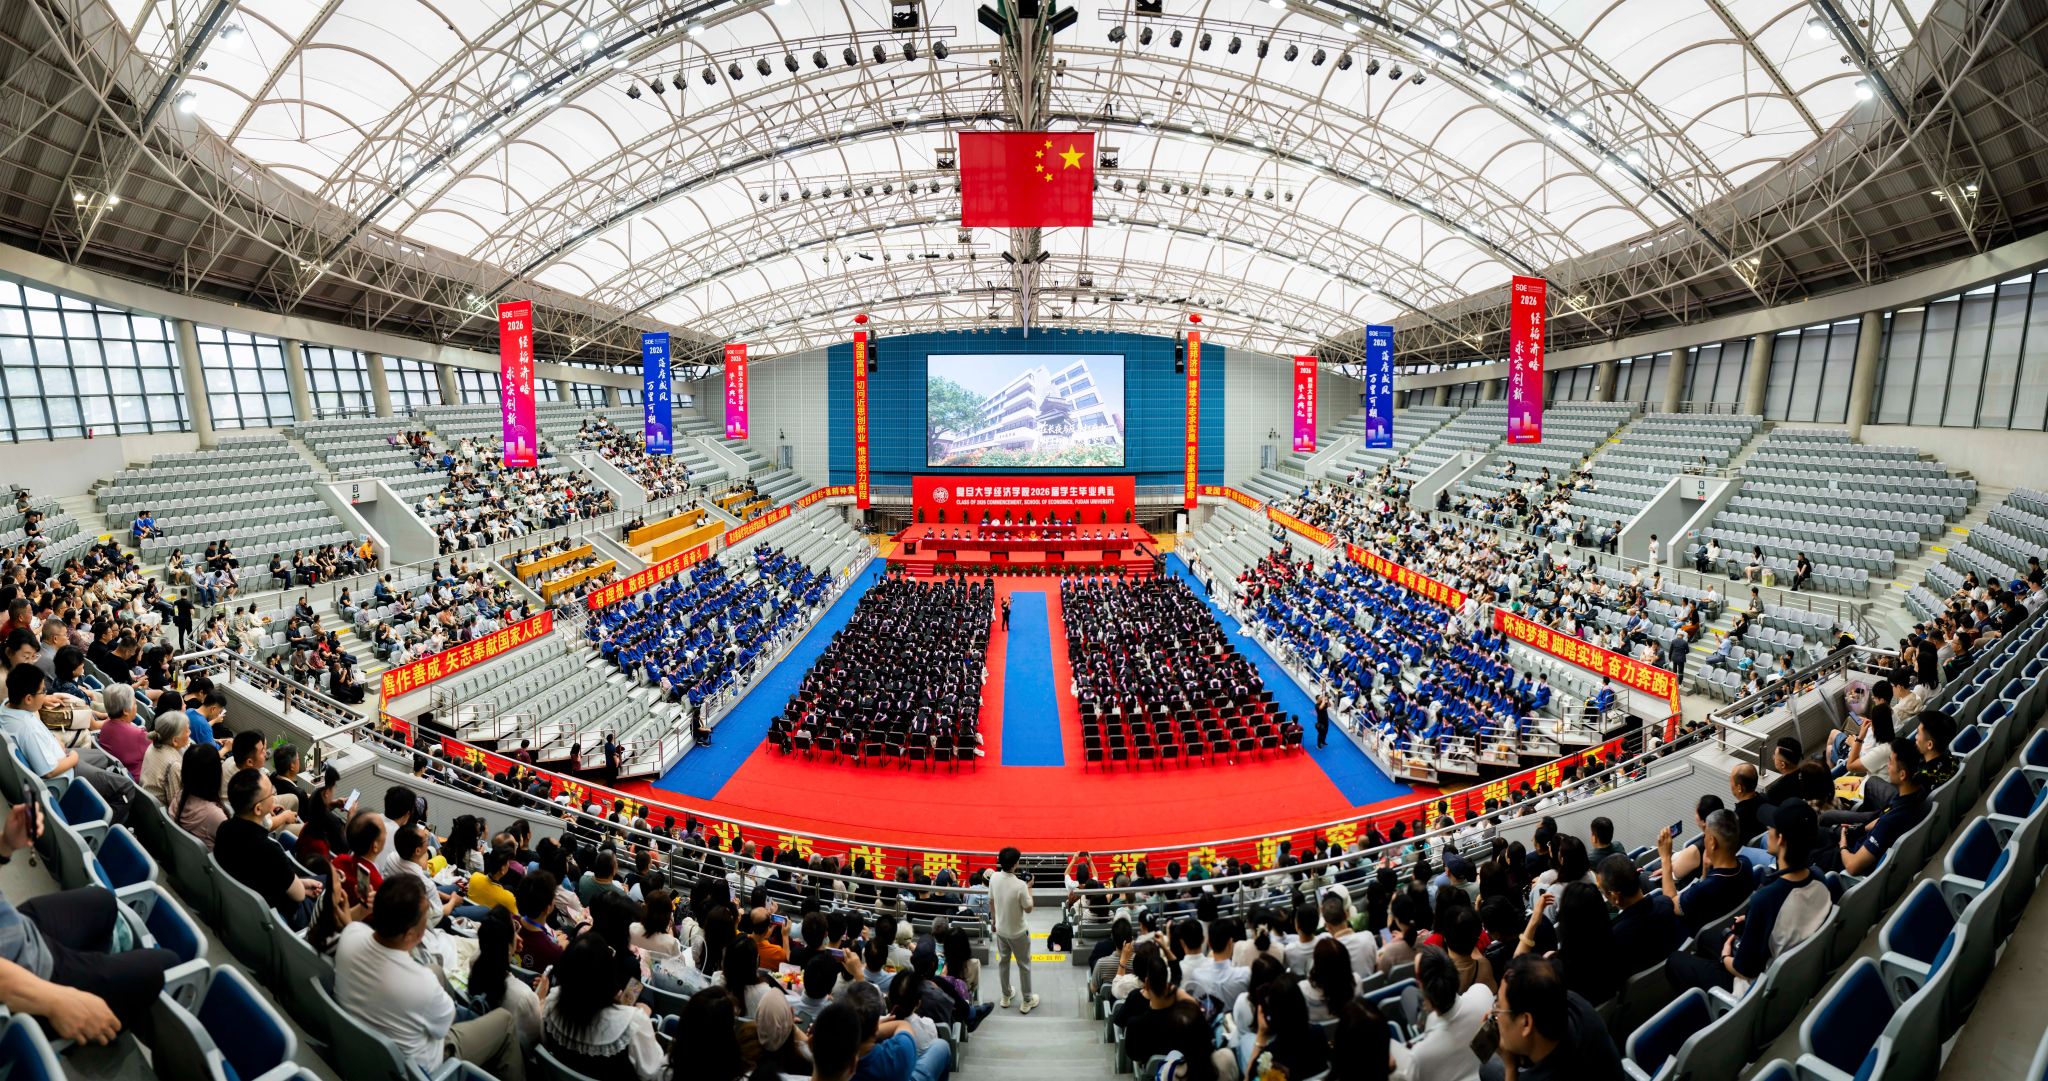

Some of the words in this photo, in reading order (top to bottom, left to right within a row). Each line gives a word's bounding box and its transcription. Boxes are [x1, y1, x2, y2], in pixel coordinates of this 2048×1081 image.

[1515, 284, 1527, 292] SOE
[1520, 295, 1537, 306] 2026
[508, 320, 524, 330] 2026
[506, 366, 516, 426] 求实创新
[1513, 340, 1524, 402] 求实创新
[595, 582, 625, 608] 有理想
[628, 570, 654, 592] 敢担当
[657, 558, 680, 579] 能吃苦
[682, 548, 702, 567] 肯奋斗
[384, 658, 442, 696] 善作善成
[446, 617, 544, 673] 矢志奉献国家人民
[1503, 615, 1549, 649] 怀抱梦想
[1552, 634, 1604, 672] 脚踏实地
[1608, 656, 1669, 696] 奋力奔跑
